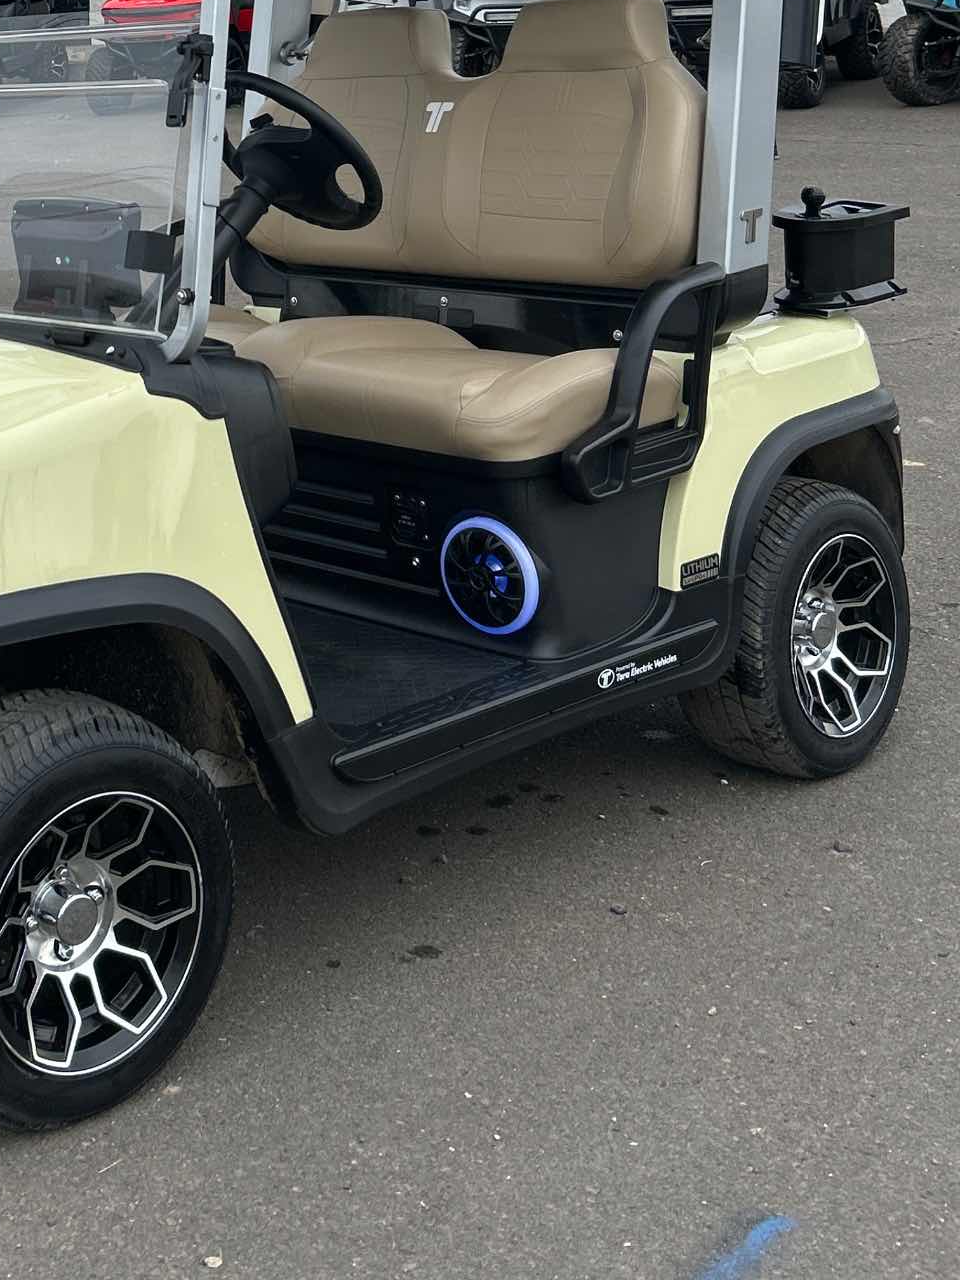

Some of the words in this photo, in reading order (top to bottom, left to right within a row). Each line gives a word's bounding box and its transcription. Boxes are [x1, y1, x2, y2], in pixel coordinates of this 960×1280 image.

[681, 555, 719, 577] LITHIUM
[630, 661, 654, 677] Electric
[653, 654, 678, 669] Vehicles
